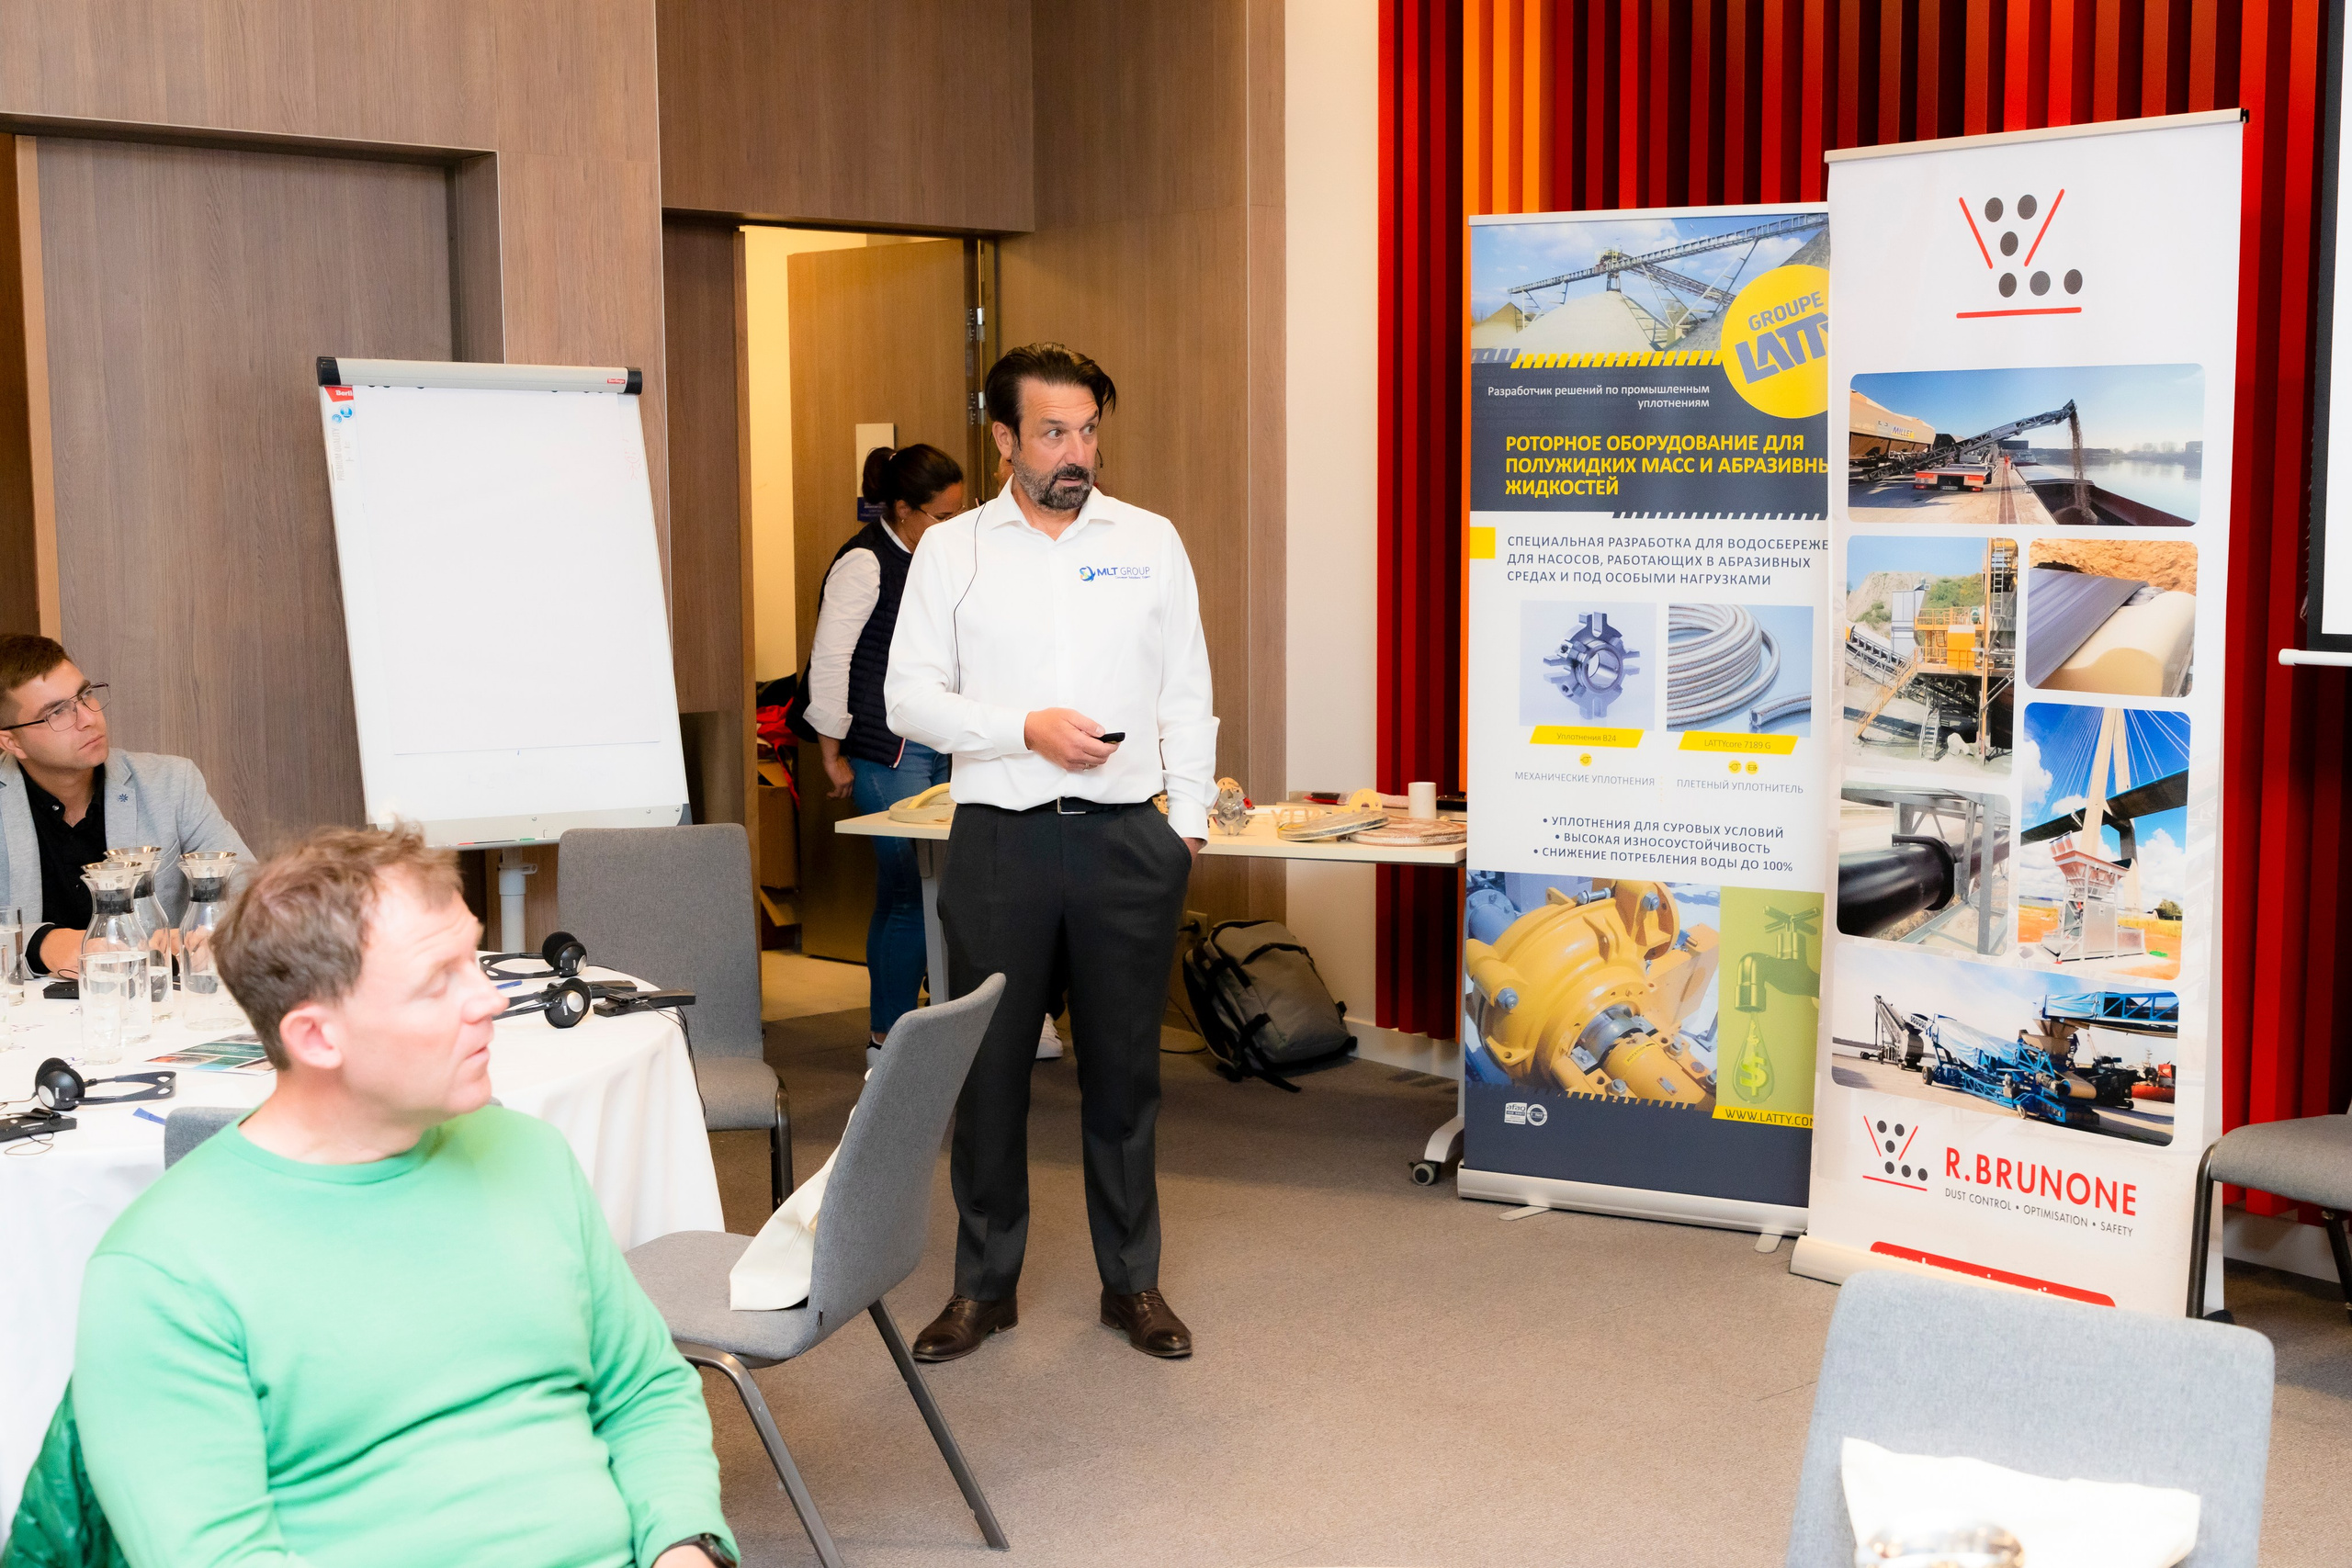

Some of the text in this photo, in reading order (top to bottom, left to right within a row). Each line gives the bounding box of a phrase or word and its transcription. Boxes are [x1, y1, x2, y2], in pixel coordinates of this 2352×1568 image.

[1748, 291, 1824, 331] GROUPE
[1735, 312, 1828, 384] LATT
[1488, 386, 1552, 398] Разработчик
[1555, 385, 1602, 397] решений
[1622, 386, 1709, 396] промышленным
[1638, 400, 1709, 410] уплотнениям
[1507, 435, 1804, 454] РОТОРНОЕ ОБОРУДОВАНИЕ ДЛЯ
[1507, 458, 1636, 476] ПОЛУЖИДКИХ
[1642, 457, 1694, 473] МАСС
[1701, 457, 1713, 472] И
[1506, 476, 1618, 498] ЖИДКОСТЕЙ
[1508, 536, 1603, 548] СПЕЦИАЛЬНАЯ
[1609, 537, 1690, 547] РАЗРАБОТКА
[1695, 538, 1723, 550] ДЛЯ
[1508, 554, 1810, 568] ДЛЯ НАСОСОВ, РАБОТАЮЩИХ В АБРАЗИВНЫХ
[1097, 567, 1149, 576] MLT GROUP
[1508, 571, 1770, 585] СРЕДАХ И ПОД ОСОБЫМИ НАГРУЗКАМИ
[1556, 733, 1601, 741] Уплотнения
[1704, 739, 1742, 748] LATTYcore
[1744, 741, 1763, 750] 7189
[1515, 772, 1654, 785] МЕХАНИЧЕСКИЕ УПЛОТНЕНИЯ
[1678, 780, 1804, 794] ПЛЕТЕНЫЙ УПЛОТНИТЕЛЬ
[1552, 817, 1782, 838] УПЛОТНЕНИЯ ДЛЯ СУРОВЫХ УСЛОВИЙ
[1565, 833, 1770, 854] ВЫСОКАЯ ИЗНОСОУСТОЙЧИВОСТЬ
[1543, 848, 1792, 871] СНИЖЕНИЕ ПОТРЕБЛЕНИЯ ВОДЫ ДО 100%
[1946, 1147, 2136, 1216] R.BRUNONE
[1946, 1188, 2132, 1236] DUST CONTROL OPTIMISATION SAFETY
